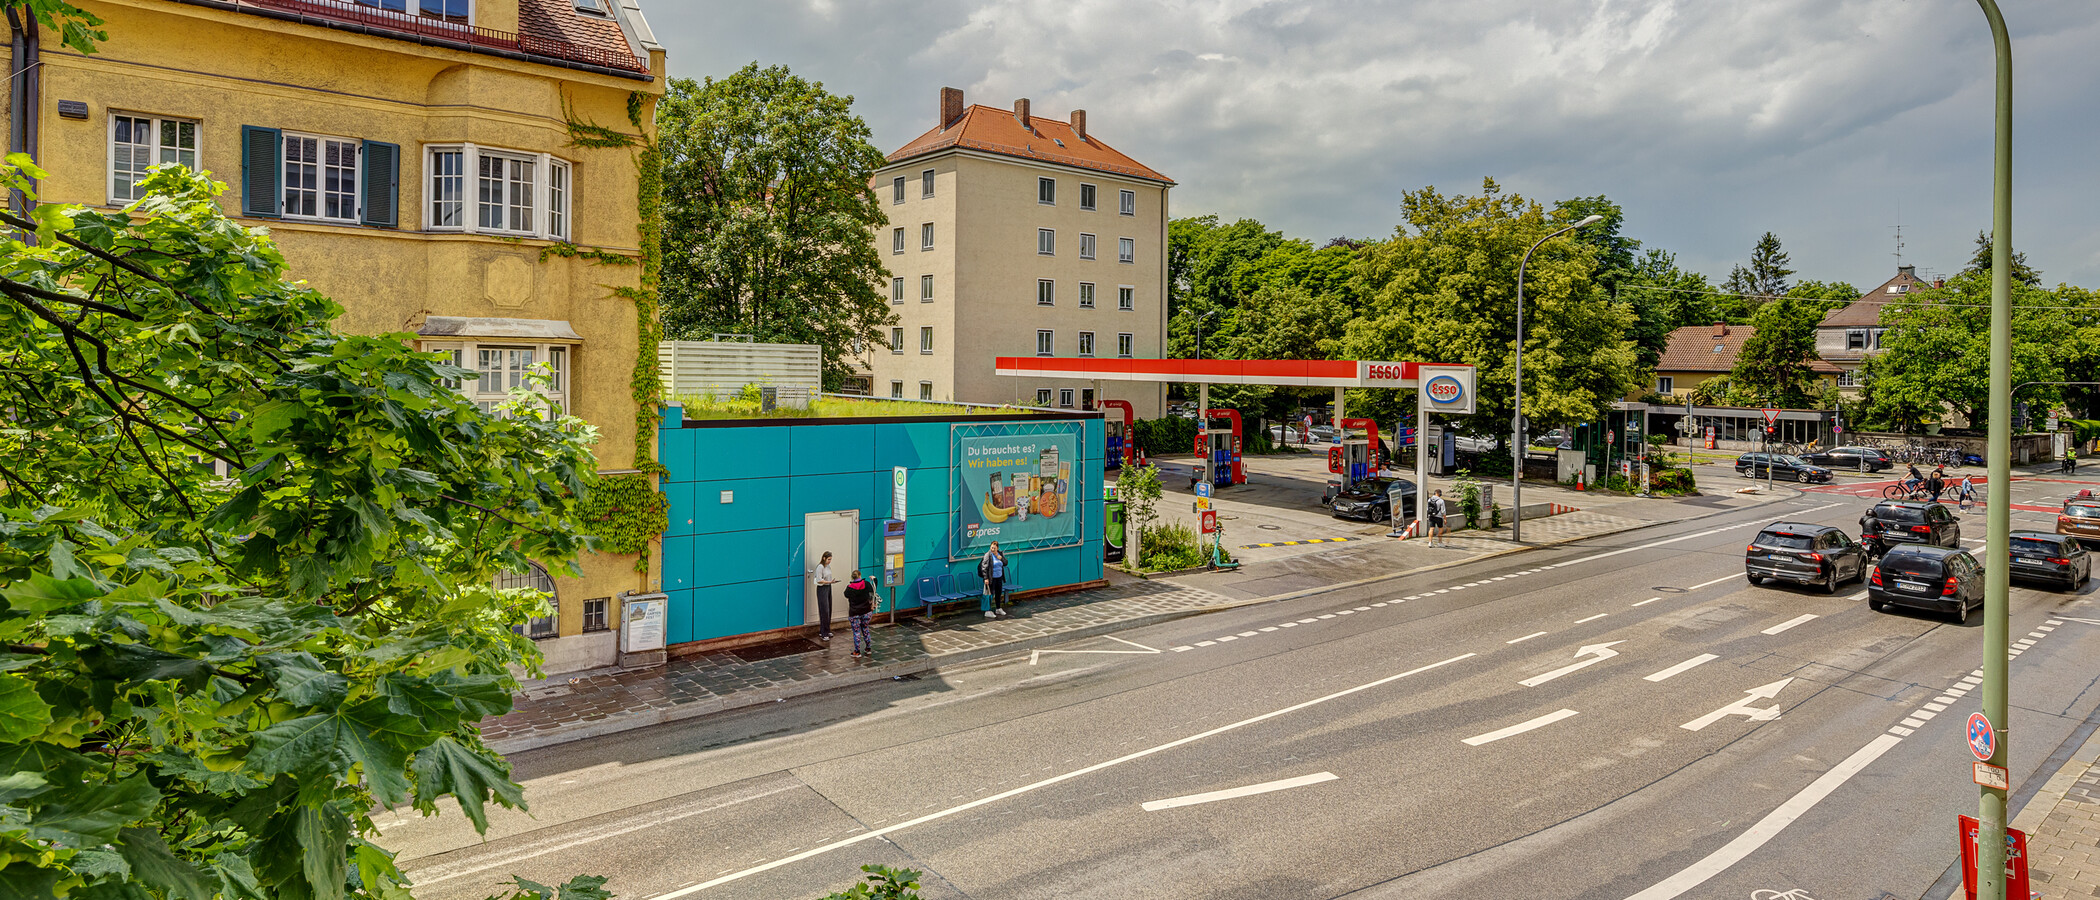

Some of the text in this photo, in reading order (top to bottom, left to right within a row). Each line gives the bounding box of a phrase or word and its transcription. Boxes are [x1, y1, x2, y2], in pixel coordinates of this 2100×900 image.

[1369, 365, 1400, 379] ESSO
[1432, 383, 1457, 395] Esso
[968, 444, 1036, 456] Du brauchst es?
[968, 457, 1028, 468] Wir haben es!
[967, 527, 1000, 538] express
